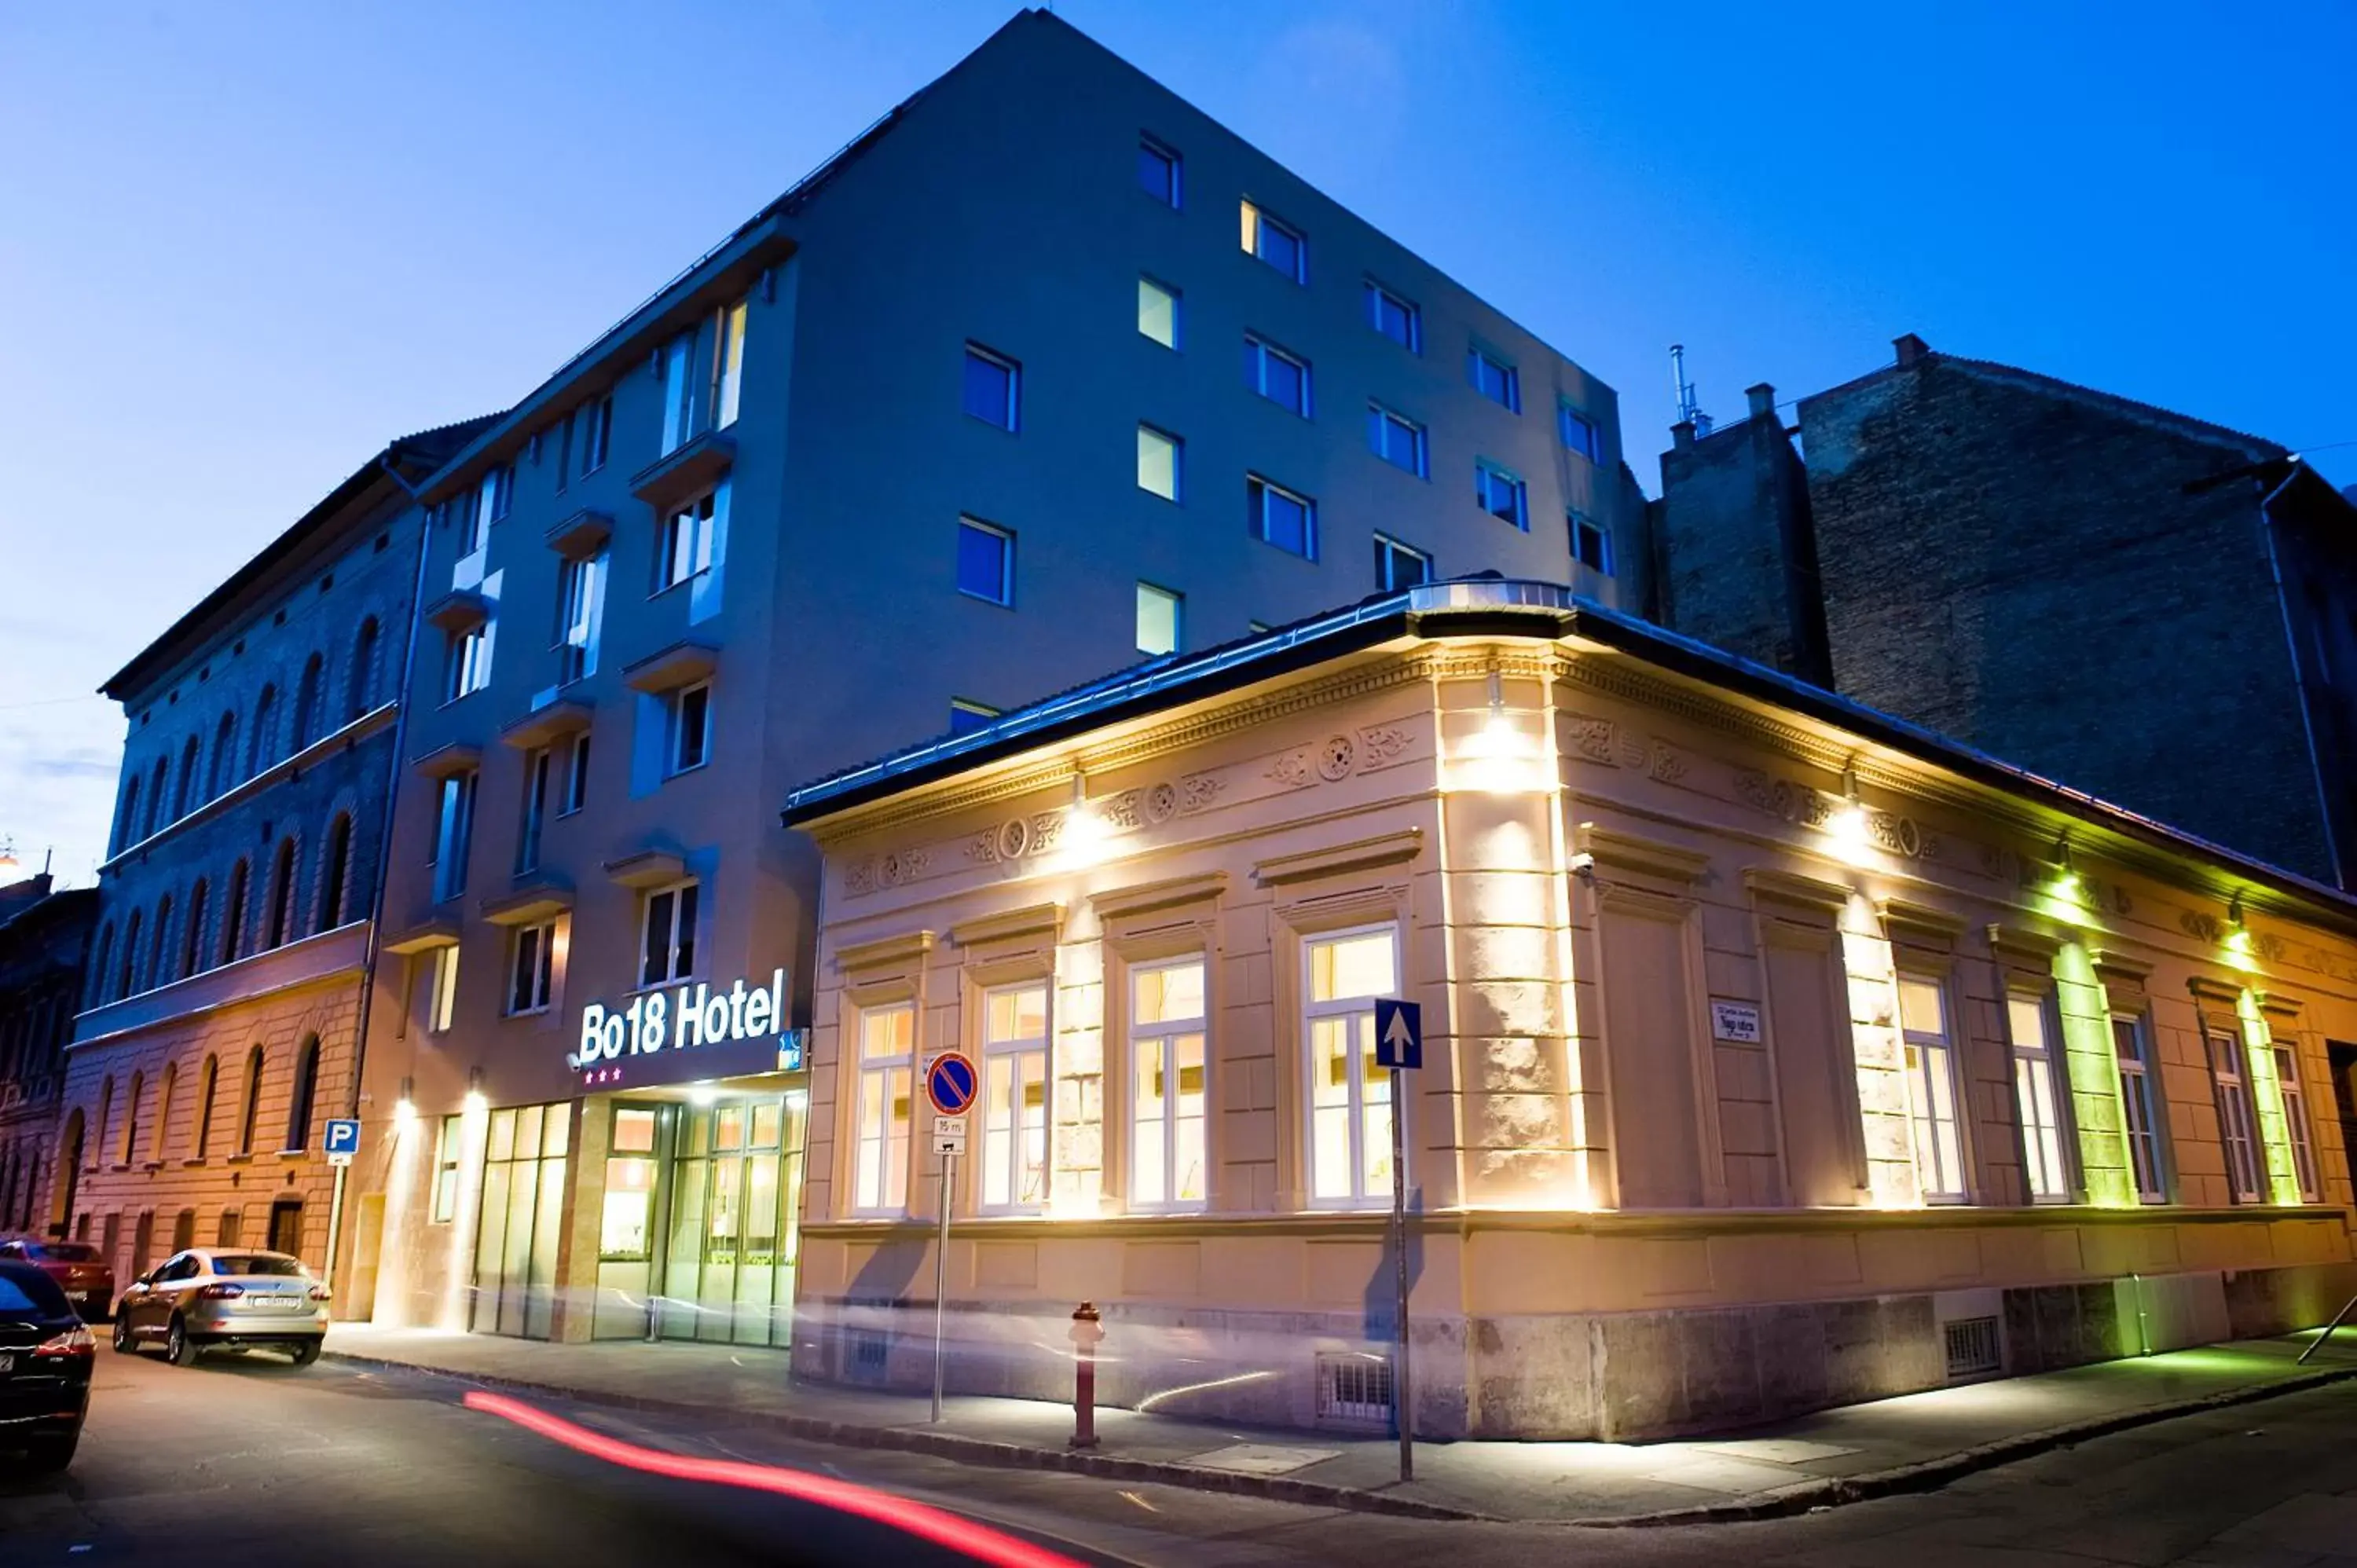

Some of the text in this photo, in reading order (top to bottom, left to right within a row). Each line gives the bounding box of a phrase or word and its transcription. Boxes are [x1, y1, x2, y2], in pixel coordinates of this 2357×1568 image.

[580, 968, 784, 1064] Bo18 Hotel
[331, 1124, 353, 1149] P
